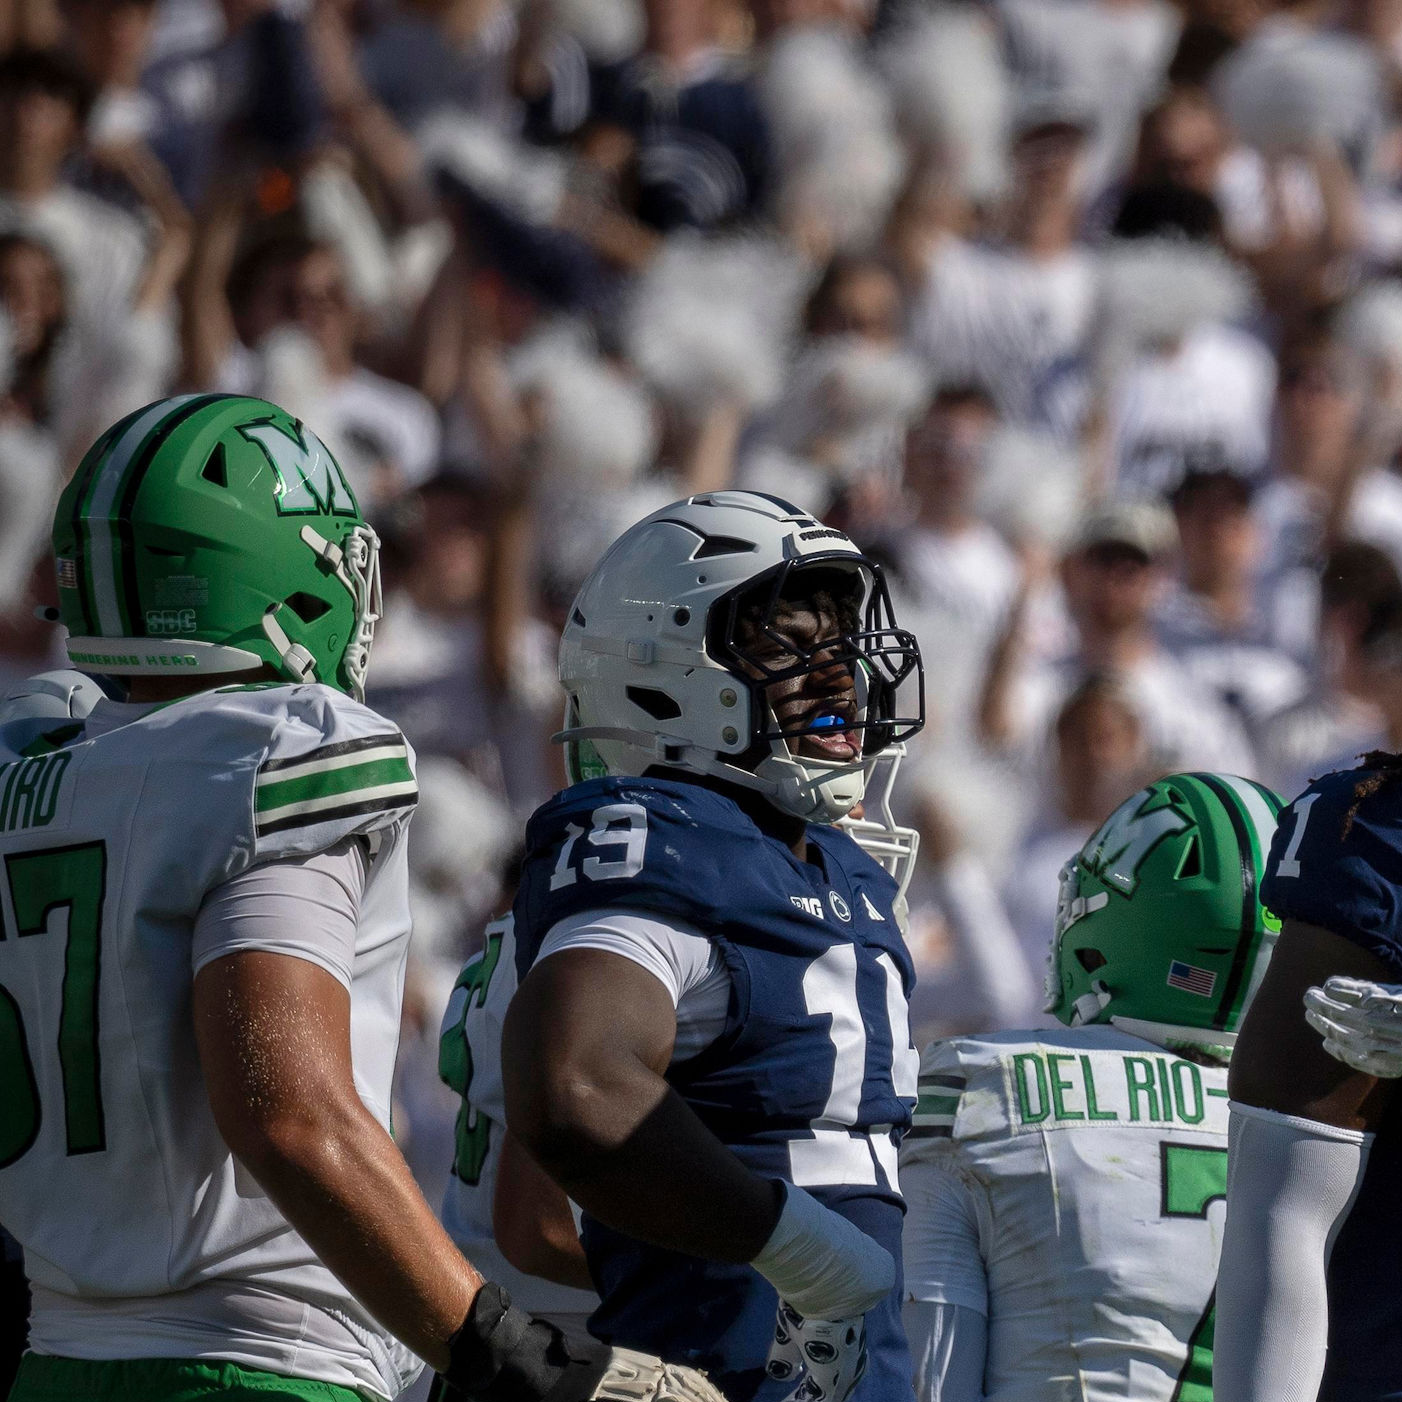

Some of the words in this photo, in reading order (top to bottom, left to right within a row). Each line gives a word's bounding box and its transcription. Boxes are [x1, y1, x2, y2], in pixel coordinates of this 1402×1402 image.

[549, 804, 648, 892] 19
[1279, 793, 1322, 877] 1
[1013, 1052, 1118, 1125] DEL
